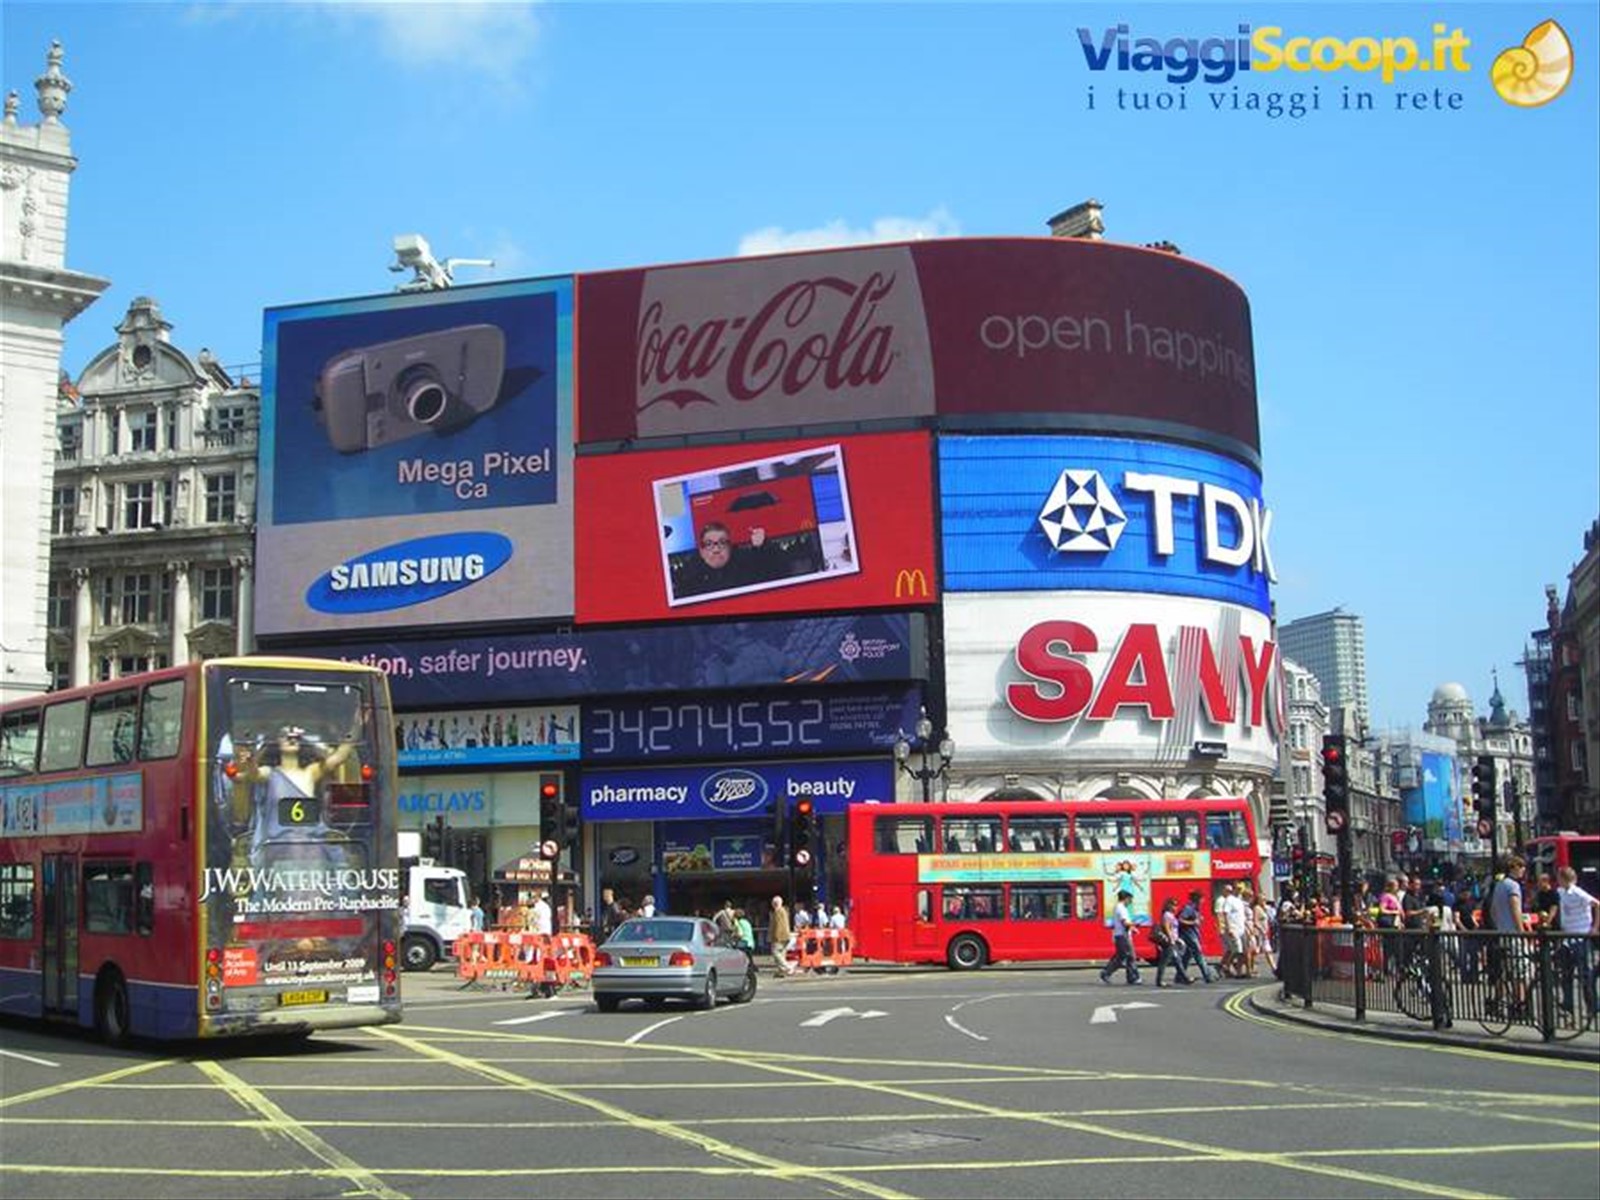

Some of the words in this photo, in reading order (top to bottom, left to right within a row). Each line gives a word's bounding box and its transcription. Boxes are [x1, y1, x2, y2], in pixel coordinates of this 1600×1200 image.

[980, 315, 1112, 358] open
[398, 458, 475, 486] Mega
[484, 448, 551, 477] Pixel
[456, 479, 488, 499] Ca
[1125, 471, 1278, 584] TDK
[330, 553, 485, 592] SAMSUNG
[420, 649, 481, 675] safer
[487, 647, 587, 677] journey.
[592, 699, 823, 755] 34,274,552
[397, 790, 485, 812] ARCLAYS
[590, 783, 688, 806] pharmacy
[709, 777, 756, 803] Boots
[787, 776, 856, 798] beauty
[291, 801, 304, 822] 6
[234, 897, 261, 913] The
[261, 897, 312, 913] Modern
[314, 895, 399, 915] Pre-Raphaelite
[264, 960, 286, 972] Until
[299, 957, 342, 973] September
